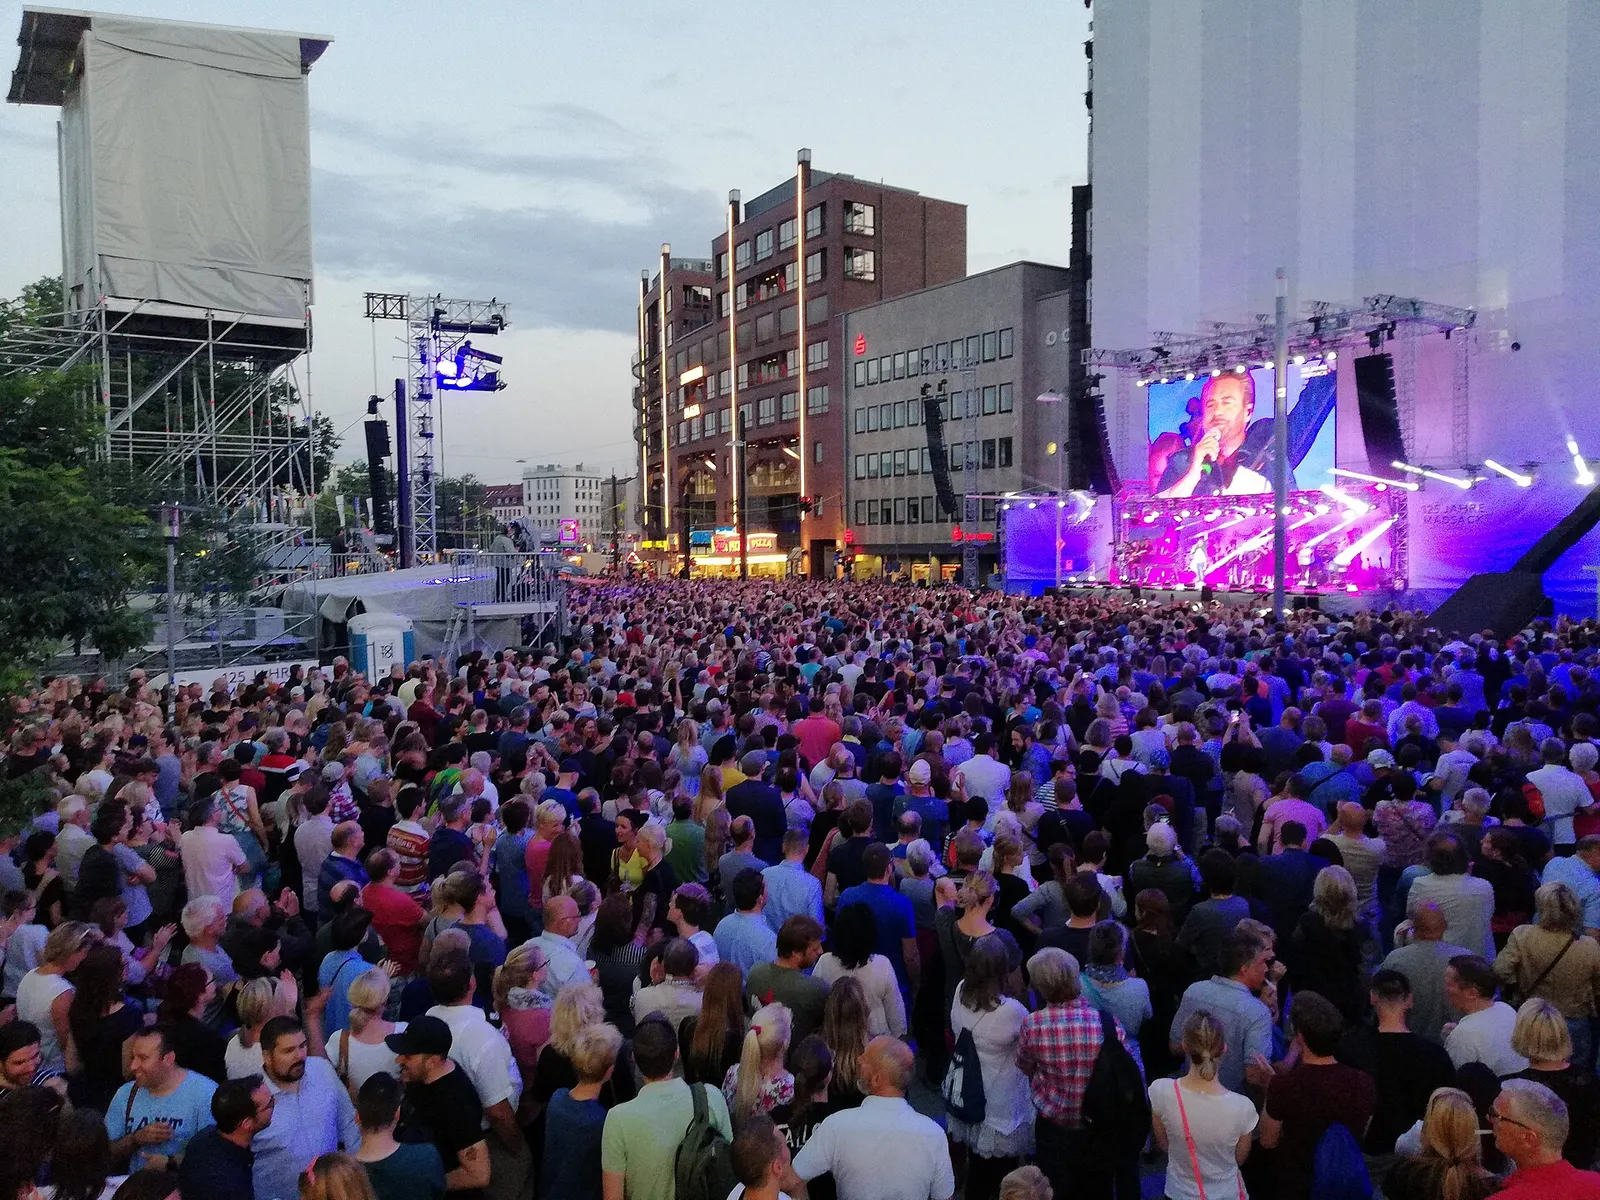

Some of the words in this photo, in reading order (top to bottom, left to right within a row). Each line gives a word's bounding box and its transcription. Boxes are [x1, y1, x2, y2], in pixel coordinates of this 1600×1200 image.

[1444, 503, 1485, 514] JAHRE
[751, 538, 773, 549] PIZZA
[222, 671, 246, 683] 125
